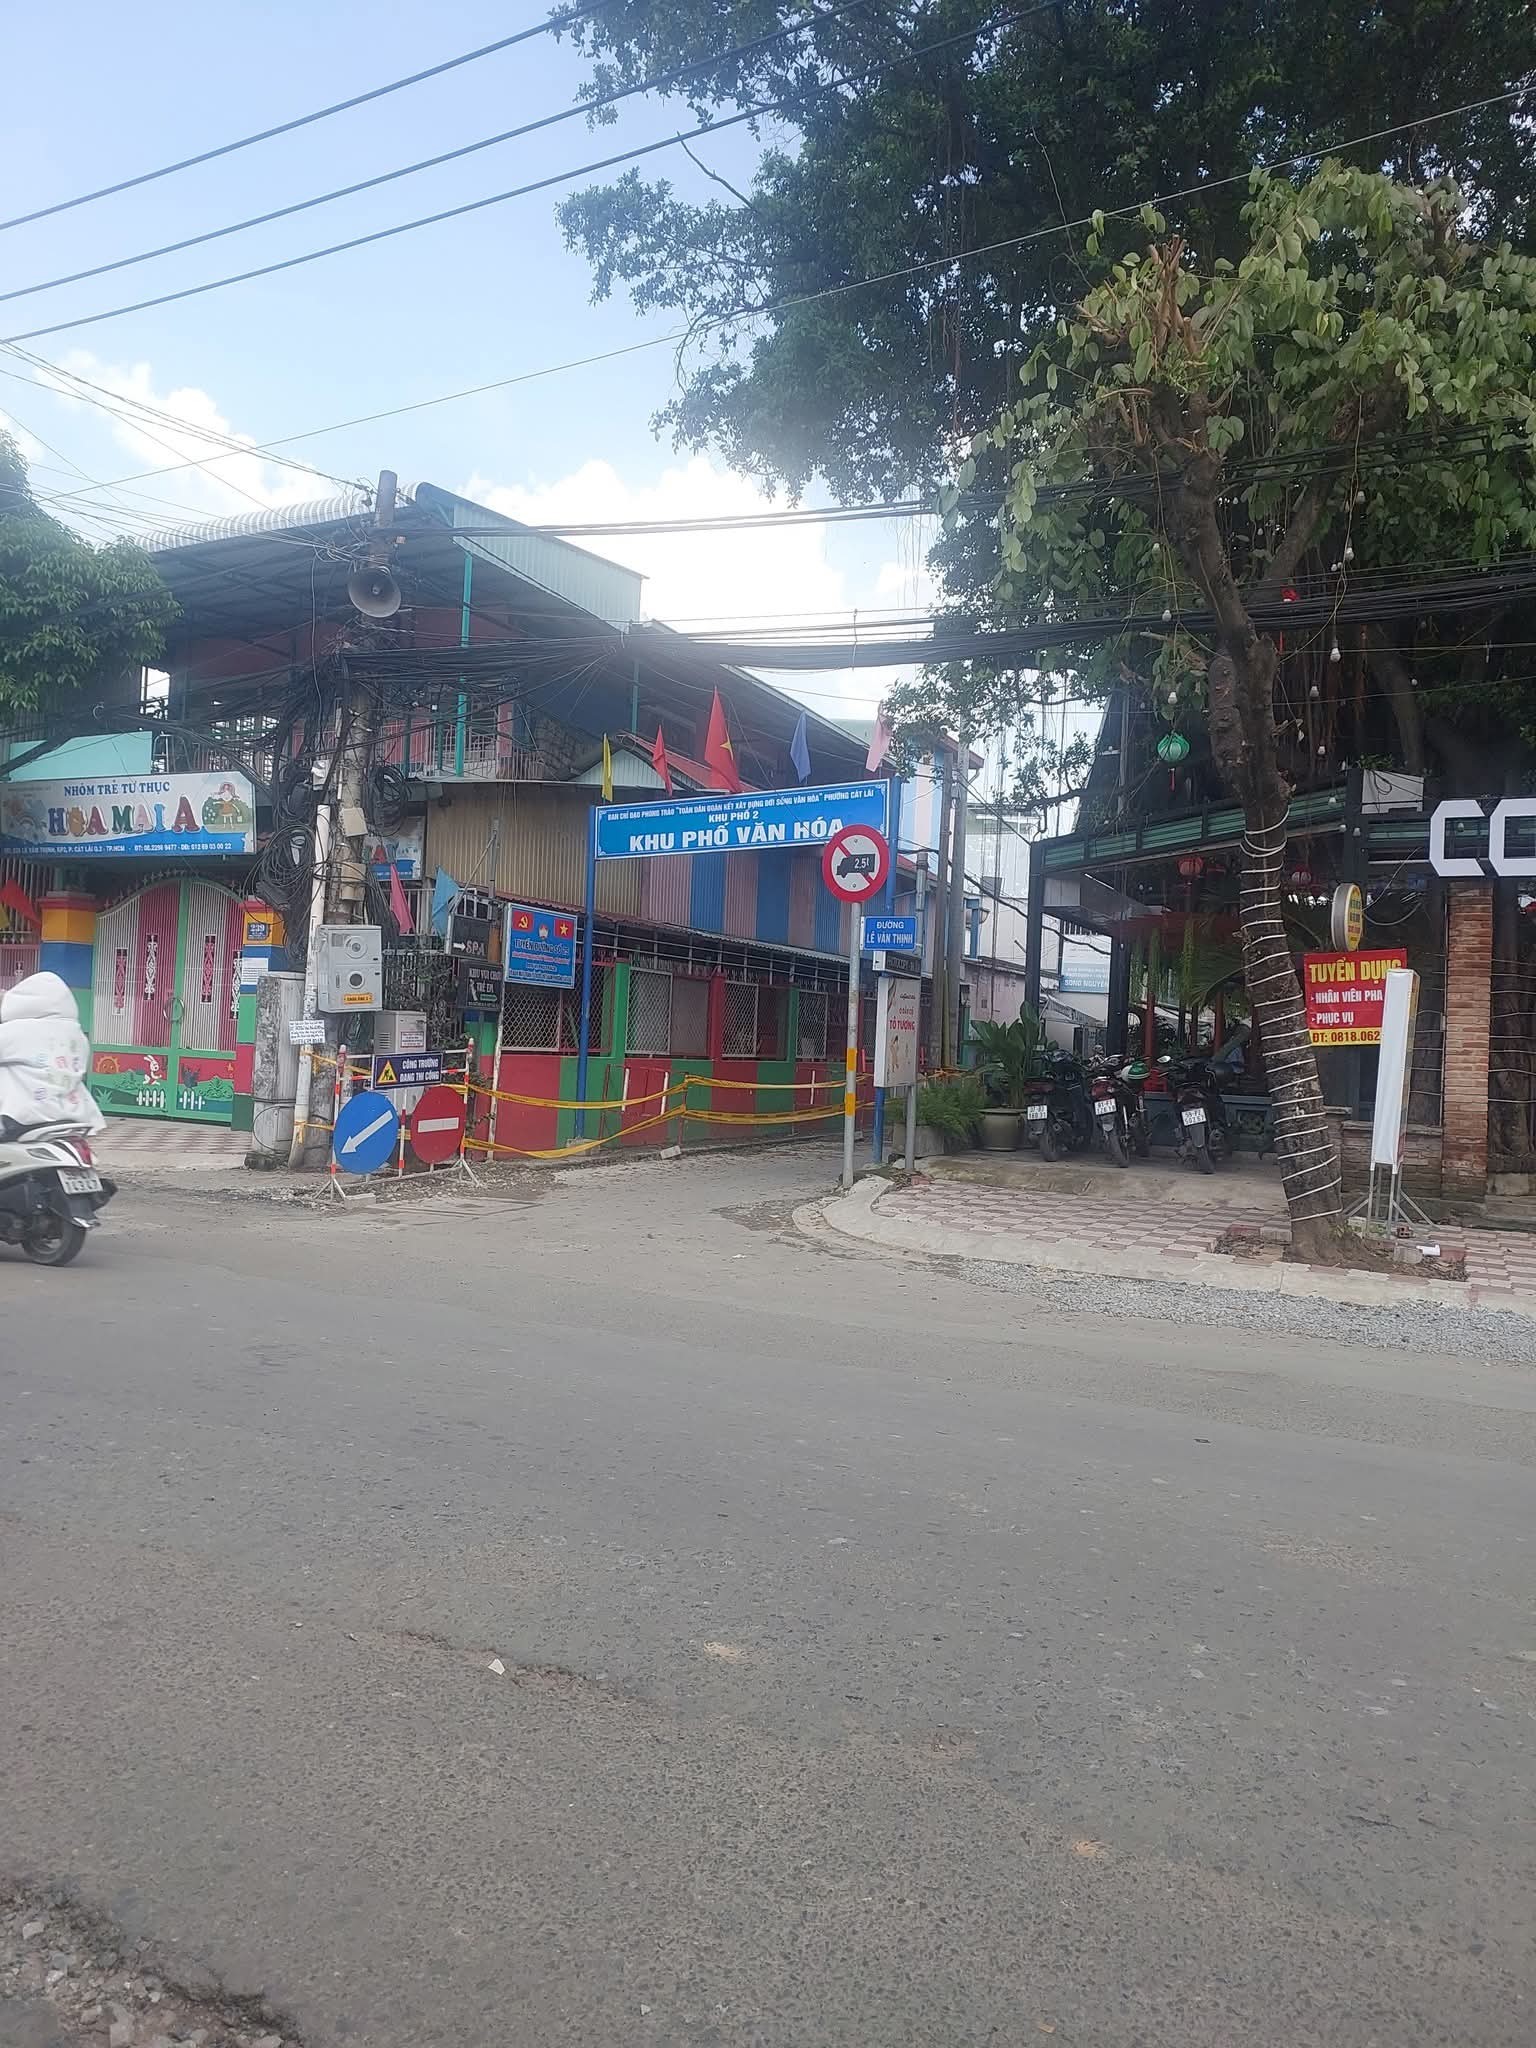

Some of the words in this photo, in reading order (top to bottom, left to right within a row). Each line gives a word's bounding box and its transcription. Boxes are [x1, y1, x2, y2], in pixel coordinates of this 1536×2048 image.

[64, 782, 95, 796] NHÓM
[97, 779, 119, 795] TRẺ
[121, 779, 137, 794] TƯ
[139, 781, 170, 795] THỤC
[607, 813, 619, 821] BAN
[641, 810, 660, 818] PHONG
[850, 789, 862, 798] CÁT
[708, 813, 728, 823] KHU
[730, 809, 750, 821] PHỐ
[752, 810, 759, 819] 2
[629, 832, 675, 852] KHU
[682, 822, 730, 848] PHỐ
[736, 821, 786, 844] VĂN
[793, 816, 845, 840] HÓA
[876, 919, 905, 929] ĐƯỜNG
[866, 930, 875, 944] LÊ
[877, 931, 891, 944] VĂN
[892, 933, 913, 946] THỊNH
[466, 940, 485, 956] SPA
[1309, 957, 1356, 983] TUYỂN
[1315, 989, 1340, 1004] NHÂN
[1342, 987, 1362, 1002] VIÊN
[1316, 1012, 1340, 1026] PHỤC
[1342, 1011, 1354, 1025] VỤ
[1312, 1032, 1328, 1043] ĐT:
[402, 1057, 417, 1070] CÔNG
[416, 1072, 424, 1081] THI
[424, 1070, 440, 1081] CÔNG
